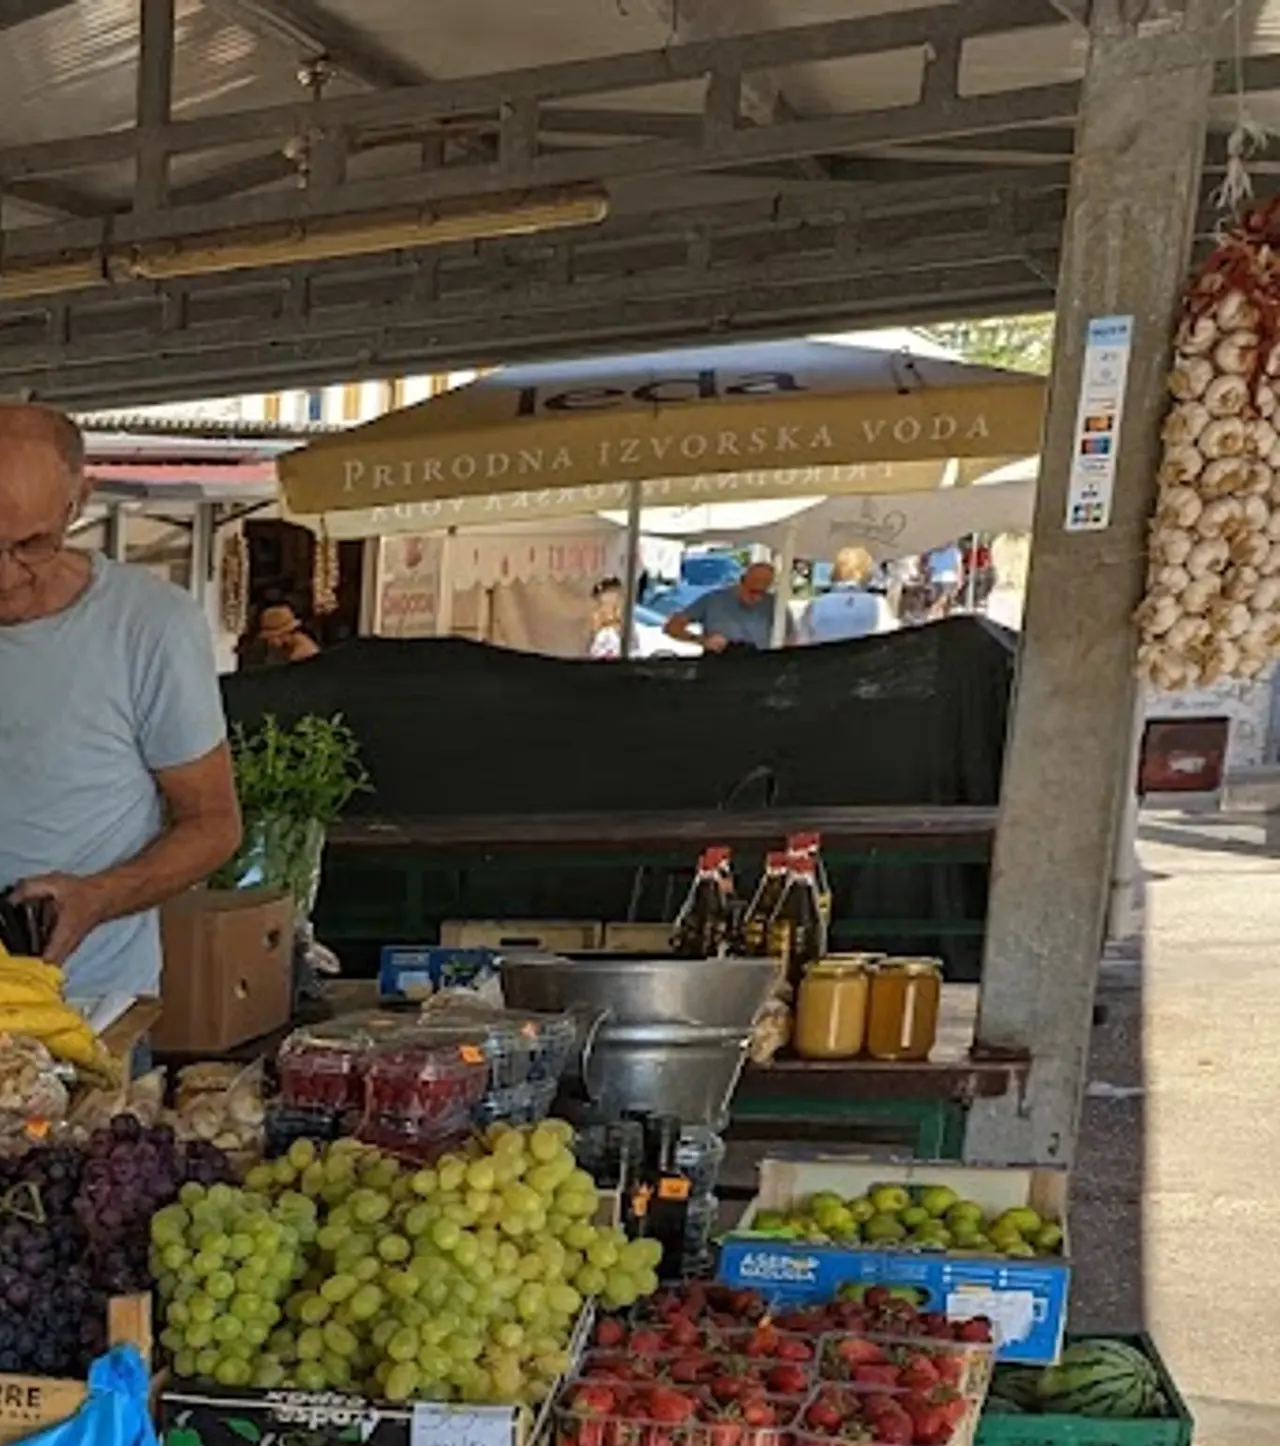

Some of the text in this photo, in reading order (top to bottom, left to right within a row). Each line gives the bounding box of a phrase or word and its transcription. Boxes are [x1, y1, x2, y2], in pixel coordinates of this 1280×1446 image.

[341, 412, 992, 494] PRIRODNA IZVORSKA VODA
